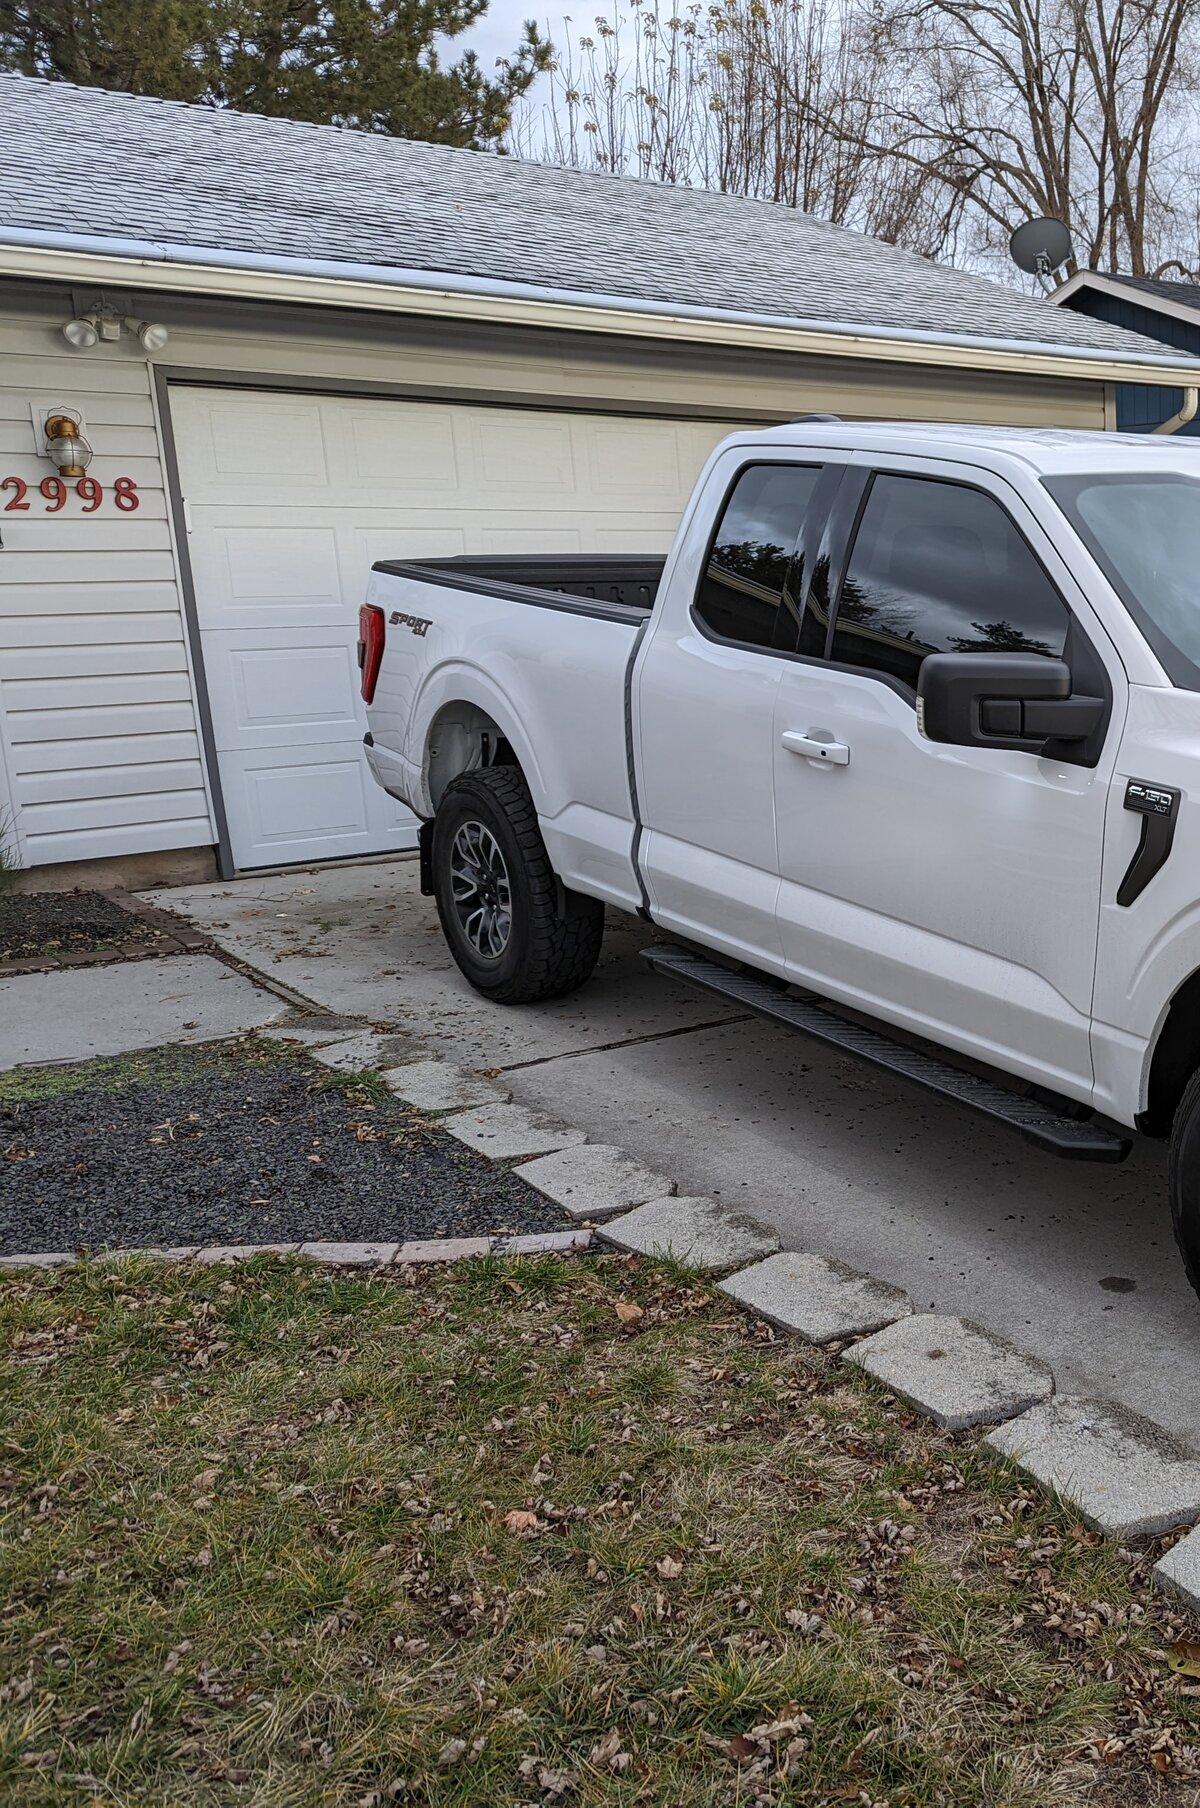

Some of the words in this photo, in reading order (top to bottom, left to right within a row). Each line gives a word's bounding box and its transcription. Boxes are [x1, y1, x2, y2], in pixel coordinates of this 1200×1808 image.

[1, 476, 140, 512] 2998
[388, 611, 434, 633] SPORT
[1154, 804, 1169, 813] XLT
